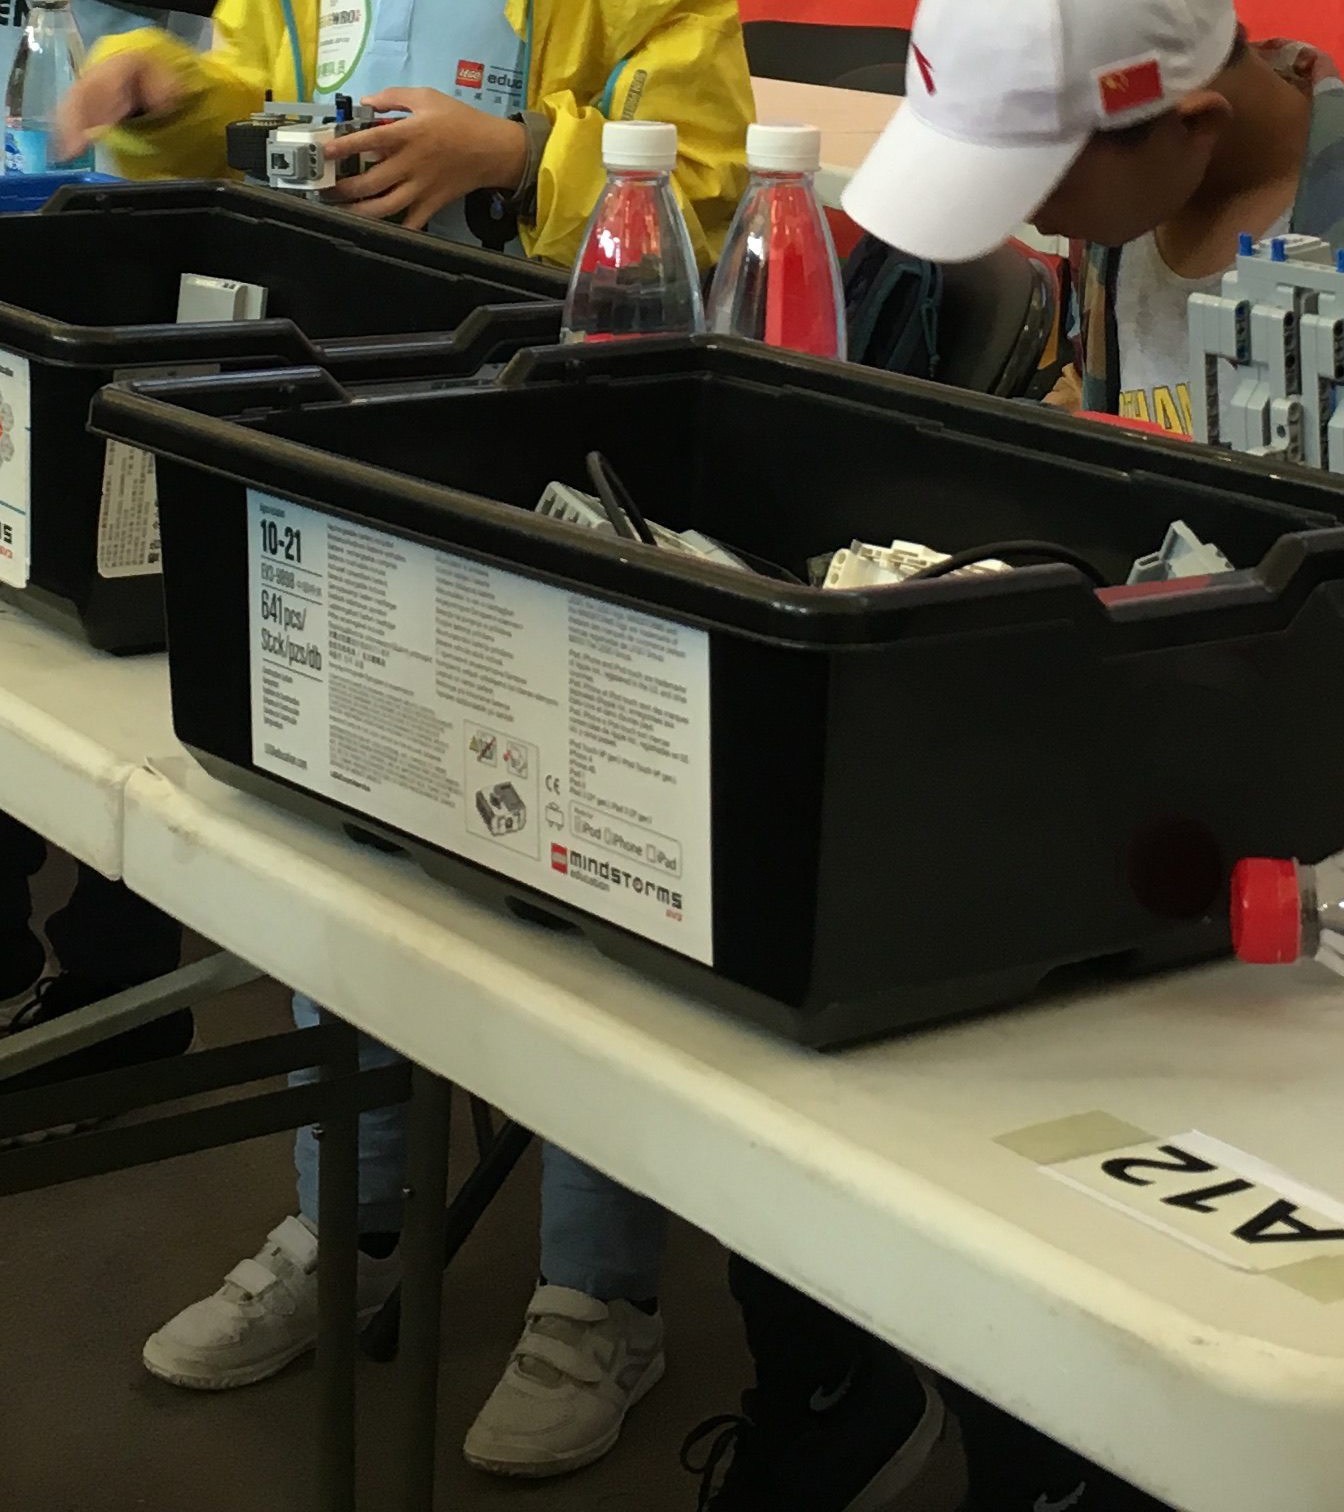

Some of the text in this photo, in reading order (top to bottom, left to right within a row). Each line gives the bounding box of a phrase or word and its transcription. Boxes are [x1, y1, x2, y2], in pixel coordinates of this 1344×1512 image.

[486, 71, 523, 89] educ
[260, 518, 302, 564] 10-21
[261, 588, 283, 626] 641
[569, 850, 684, 909] mindstorms
